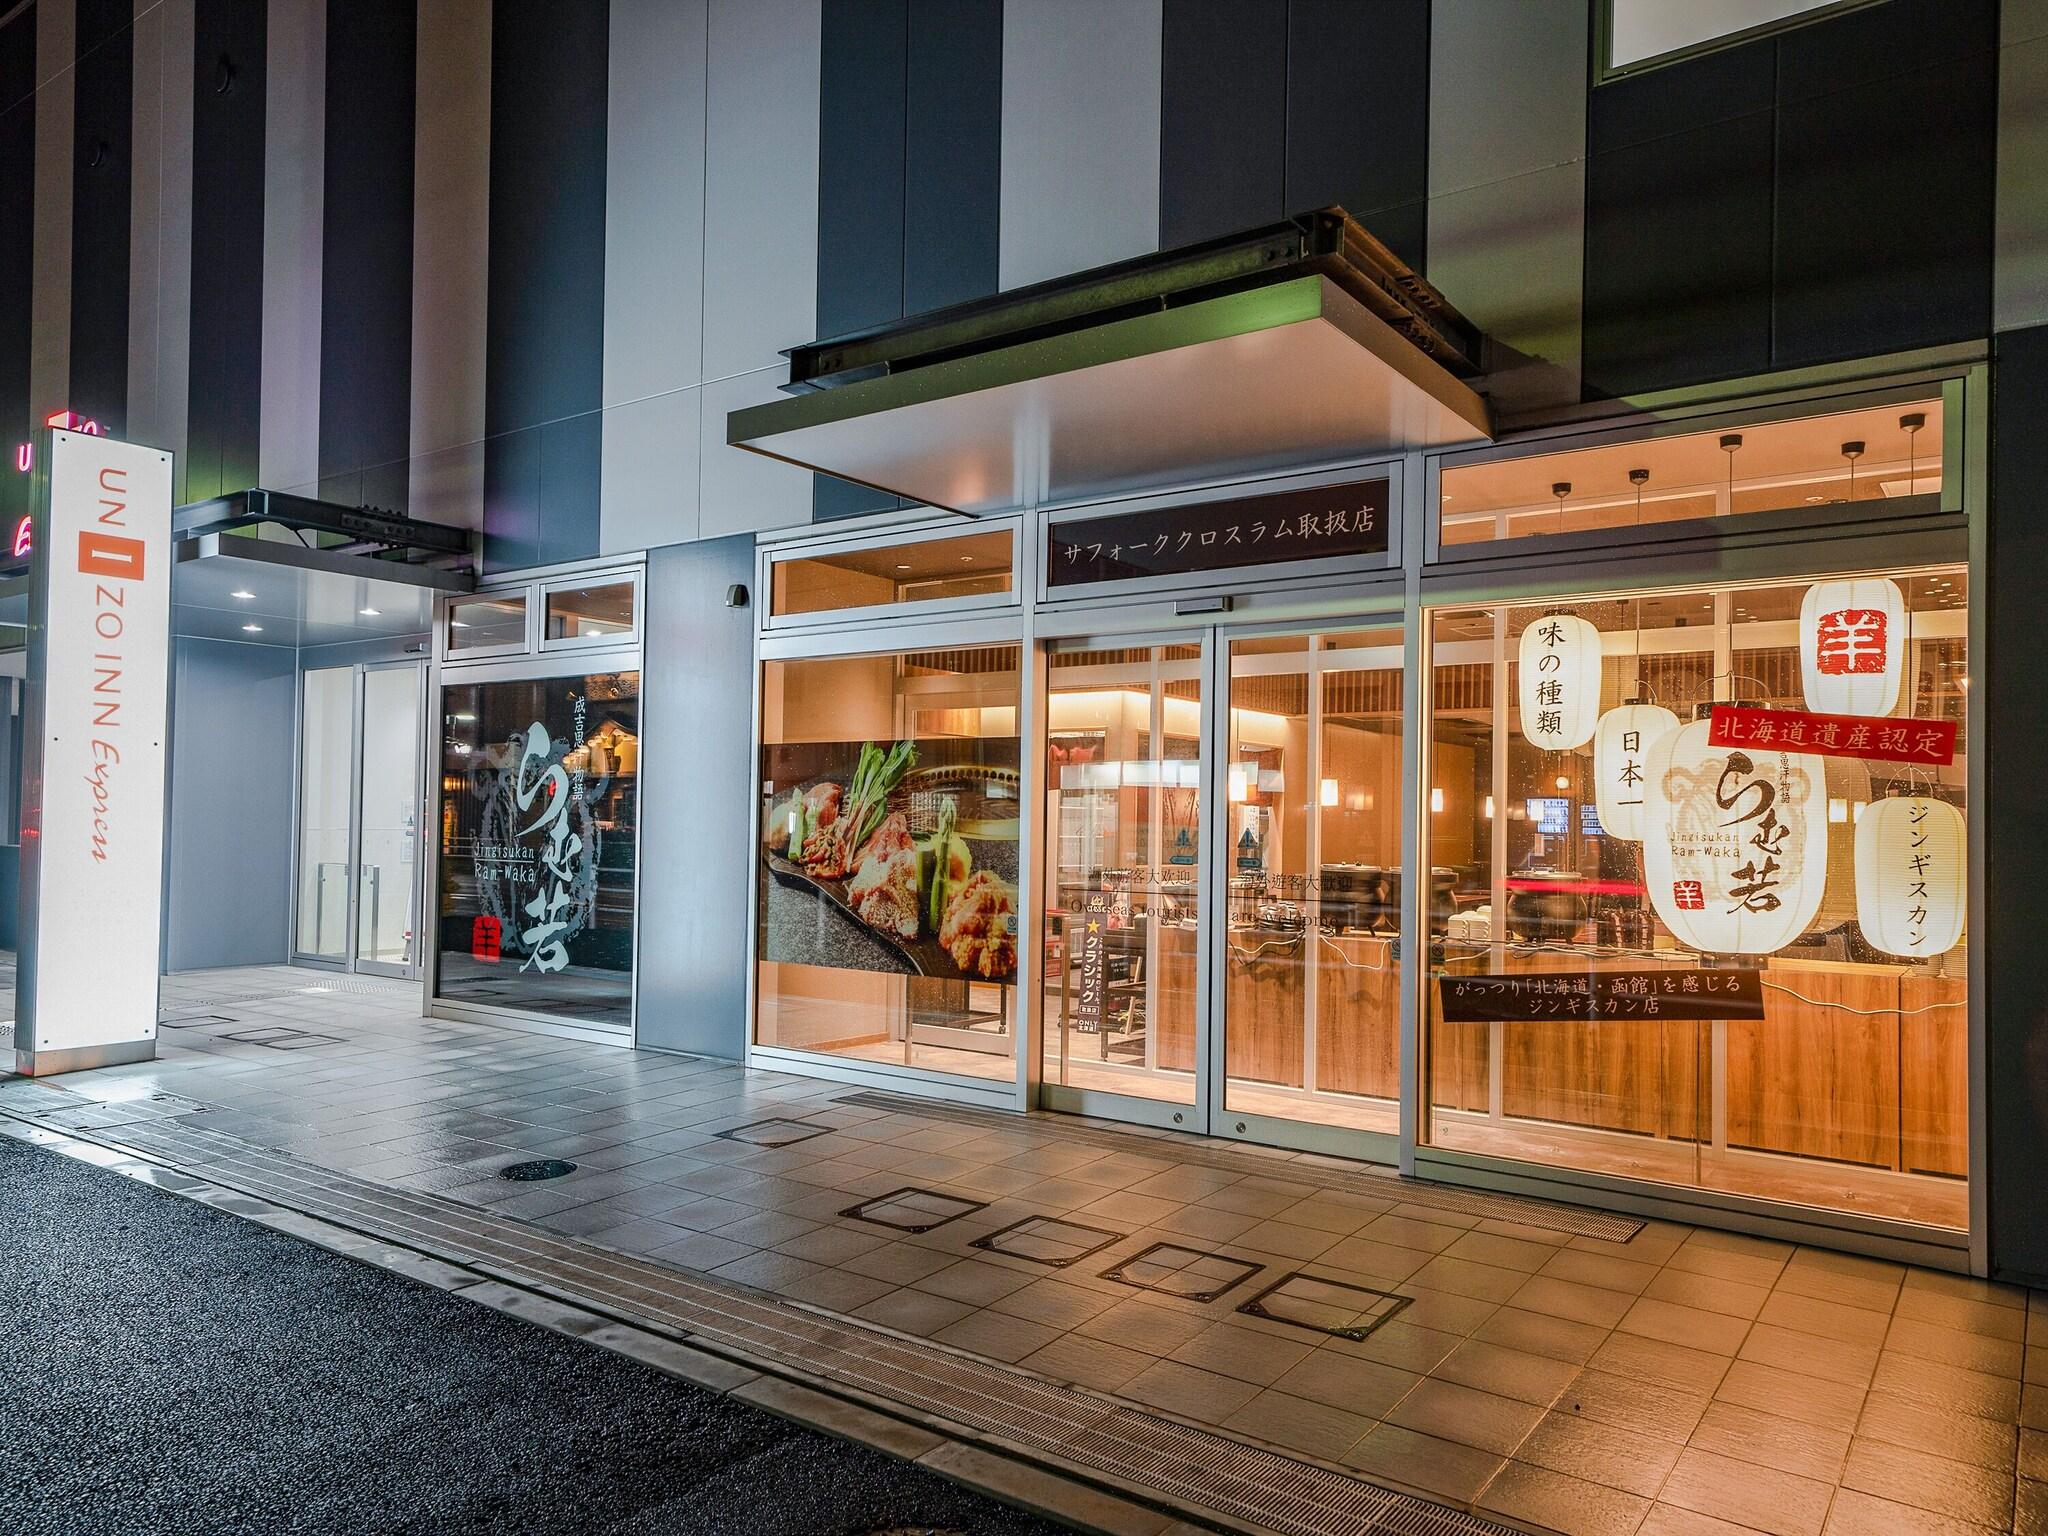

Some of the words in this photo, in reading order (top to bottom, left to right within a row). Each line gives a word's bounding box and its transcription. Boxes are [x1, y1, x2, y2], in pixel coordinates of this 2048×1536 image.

[1063, 504, 1375, 565] サフォーククロスラム取扱店
[1819, 610, 1887, 673] 羊
[1536, 621, 1566, 736] 味の種類
[1717, 716, 1945, 758] 北海道遺産認定
[1617, 730, 1644, 806] 日本一
[1779, 752, 1791, 804] 吉思汗物語
[84, 739, 120, 864] Express
[474, 842, 534, 859] Jingisukan
[1671, 832, 1739, 842] Jingisukan
[1671, 846, 1741, 858] Ram-Waka
[474, 863, 535, 882] Ram-Waka
[1908, 805, 1932, 946] ジンギスカン
[1675, 881, 1703, 909] 羊
[1232, 911, 1257, 922] are
[473, 919, 498, 961] 羊
[1083, 936, 1098, 1002] クラシック
[1529, 996, 1660, 1015] ジンギスカン店
